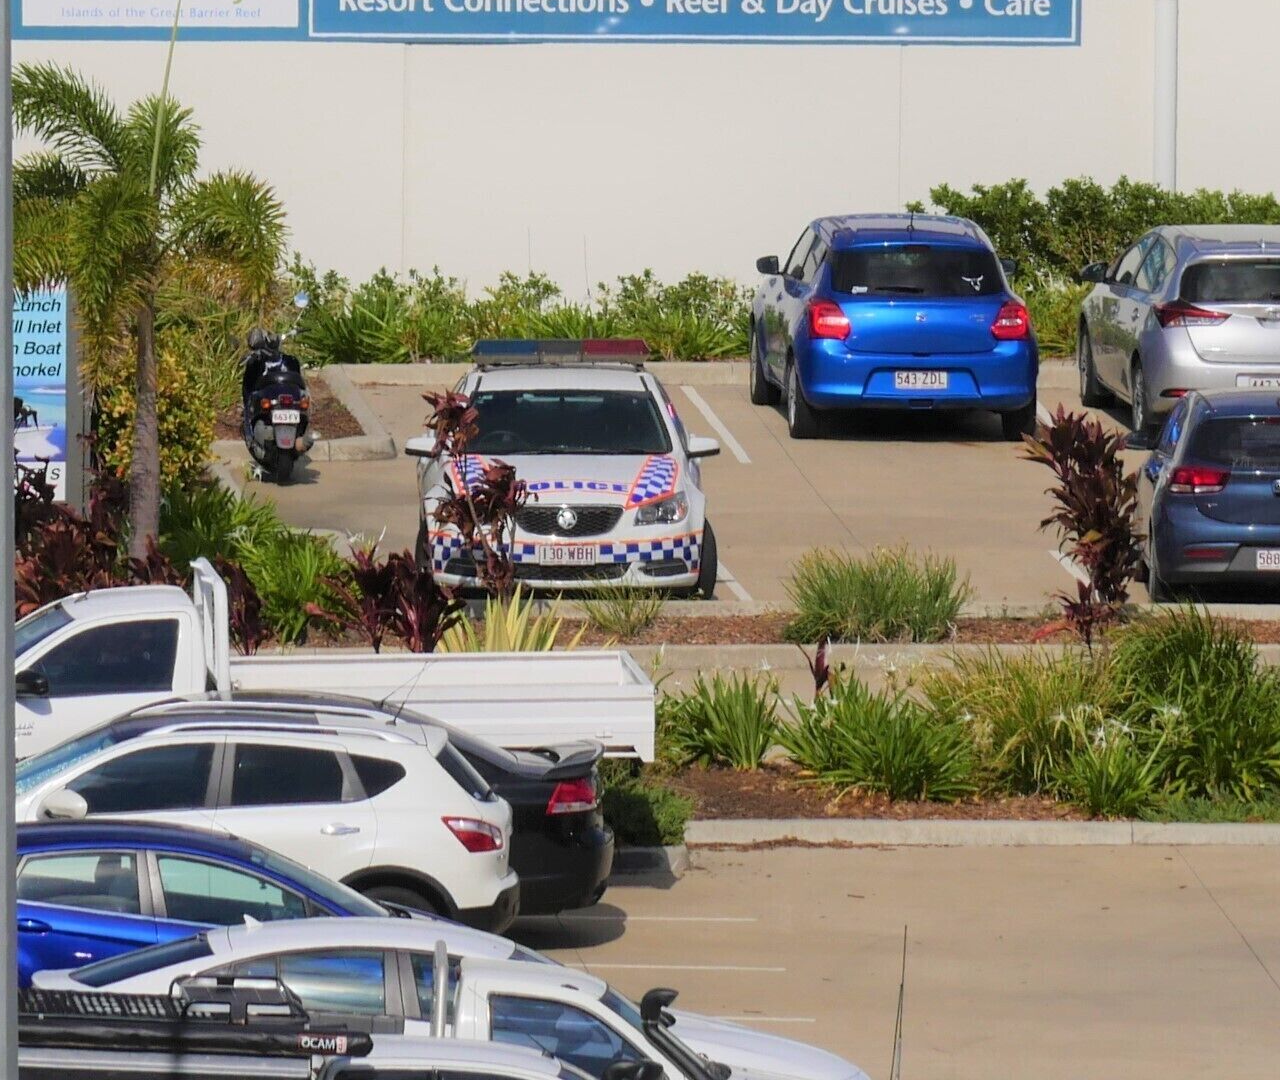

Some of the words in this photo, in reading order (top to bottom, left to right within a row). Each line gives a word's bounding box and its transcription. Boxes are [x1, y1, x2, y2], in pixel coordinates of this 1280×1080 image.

[61, 7, 103, 18] Islands
[108, 7, 120, 18] of
[125, 7, 146, 18] the
[150, 7, 184, 18] Great
[189, 7, 230, 19] Barrier
[235, 7, 261, 18] Reef
[27, 319, 62, 333] Inlet
[23, 341, 62, 355] Boat
[12, 363, 61, 377] norkel
[897, 372, 917, 385] 543
[528, 481, 628, 491] OLICE
[567, 547, 593, 561] WBH
[301, 1035, 335, 1050] OCAM
